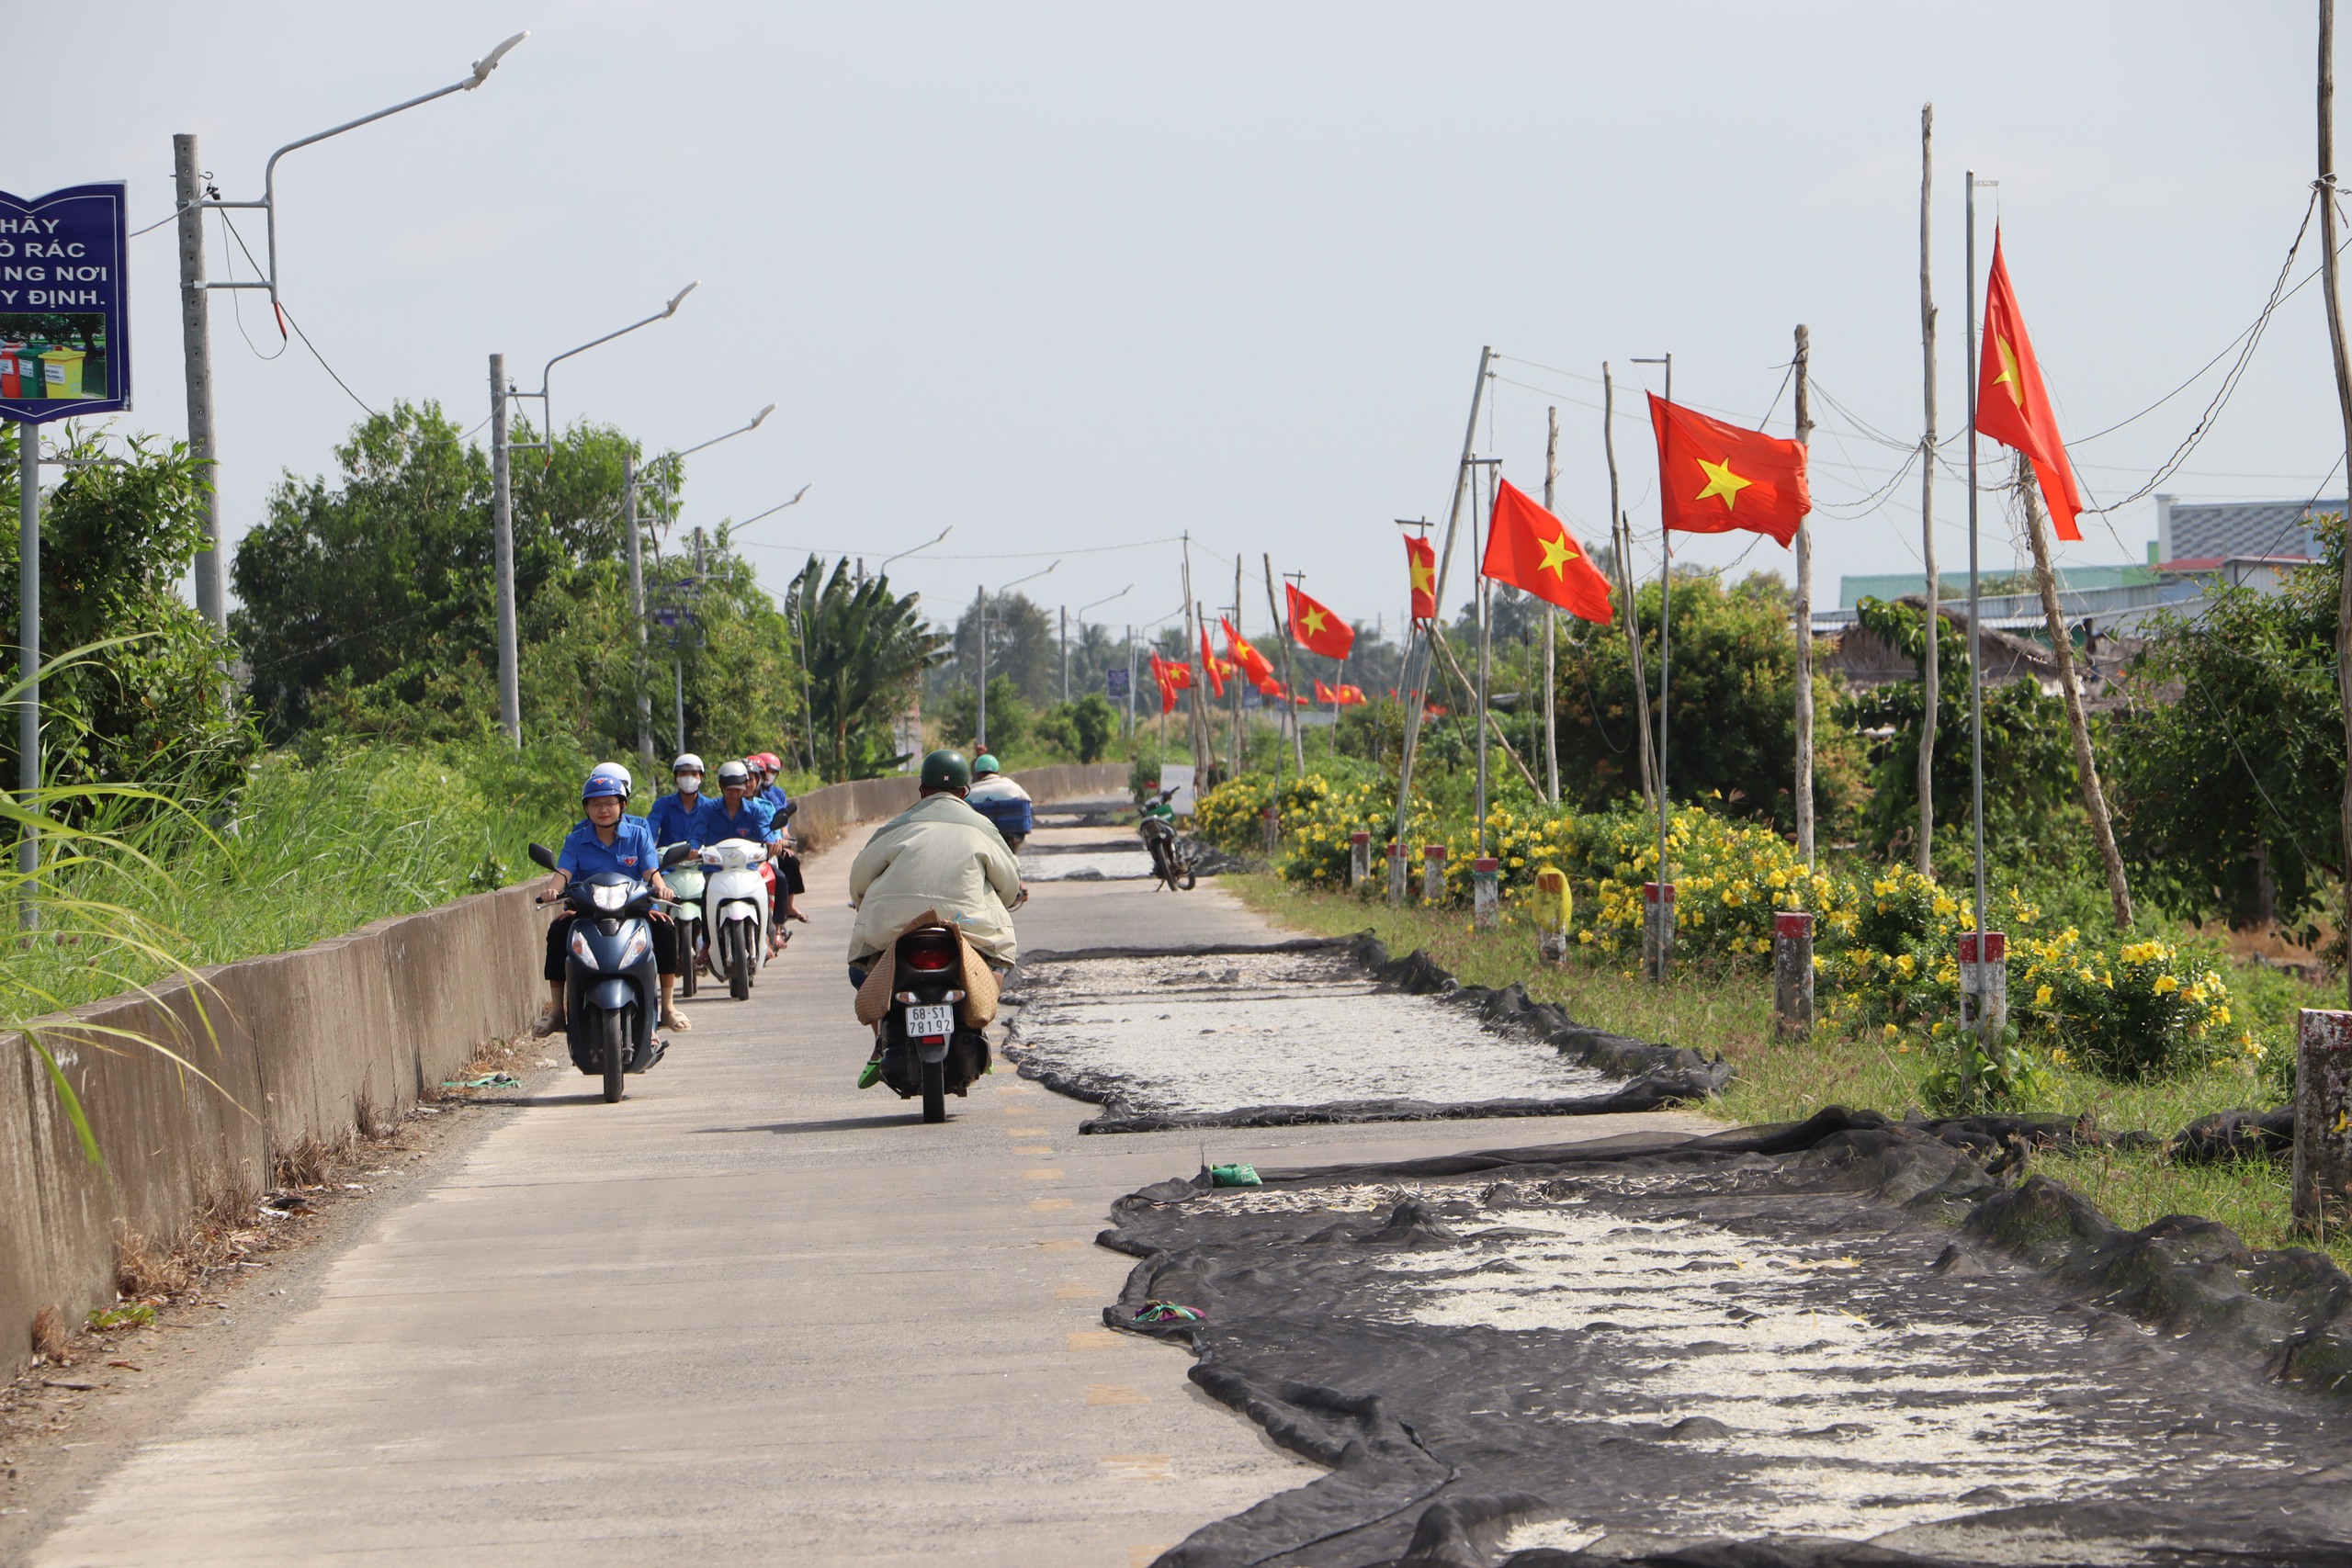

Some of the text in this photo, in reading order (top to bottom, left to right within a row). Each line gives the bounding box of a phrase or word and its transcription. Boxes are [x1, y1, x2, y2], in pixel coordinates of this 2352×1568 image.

[0, 215, 60, 234] HÃY
[25, 239, 86, 258] RÁC
[0, 266, 107, 282] NG NƠI
[28, 289, 106, 309] ĐỊNH.
[912, 1007, 944, 1021] 68-S1
[910, 1020, 951, 1034] 781.92
